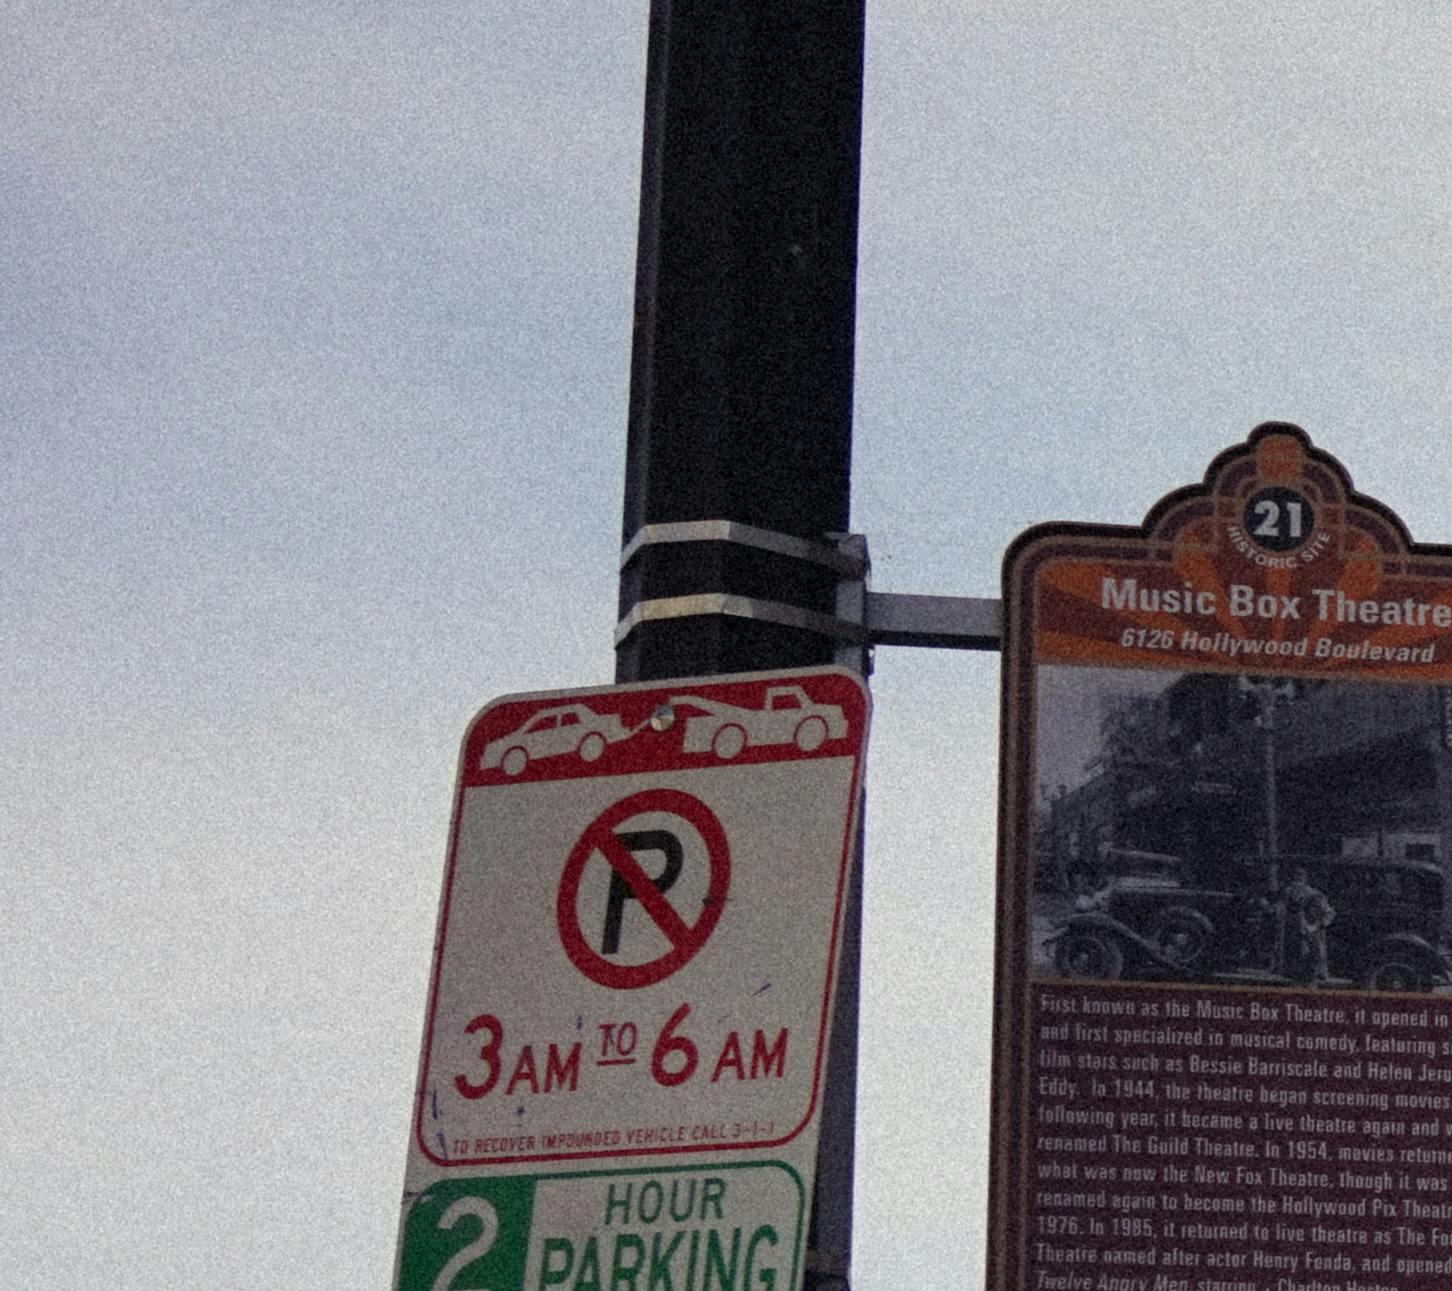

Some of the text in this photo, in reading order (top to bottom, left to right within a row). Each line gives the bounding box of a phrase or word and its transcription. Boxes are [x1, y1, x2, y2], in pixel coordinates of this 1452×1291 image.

[1253, 500, 1302, 539] 21
[1226, 525, 1331, 570] HISTORIC SITE
[1100, 577, 1452, 628] Music Box Theatre
[1121, 628, 1436, 664] 6126 Hollywood Boulevard
[1041, 993, 1075, 1014] First
[1082, 996, 1135, 1015] known
[1142, 1002, 1159, 1017] as
[1166, 1000, 1190, 1018] the
[1197, 1000, 1243, 1020] Music
[1250, 1002, 1279, 1021] Box
[1355, 1006, 1365, 1024] it
[1372, 1010, 1428, 1029] opened
[1435, 1012, 1448, 1028] in
[597, 1022, 638, 1065] TO
[473, 1136, 534, 1155] RECOVER
[540, 1129, 620, 1151] IMPOUNDED
[626, 1124, 686, 1146] VEHICLE
[692, 1123, 729, 1143] CALL
[604, 1177, 728, 1226] HOUR
